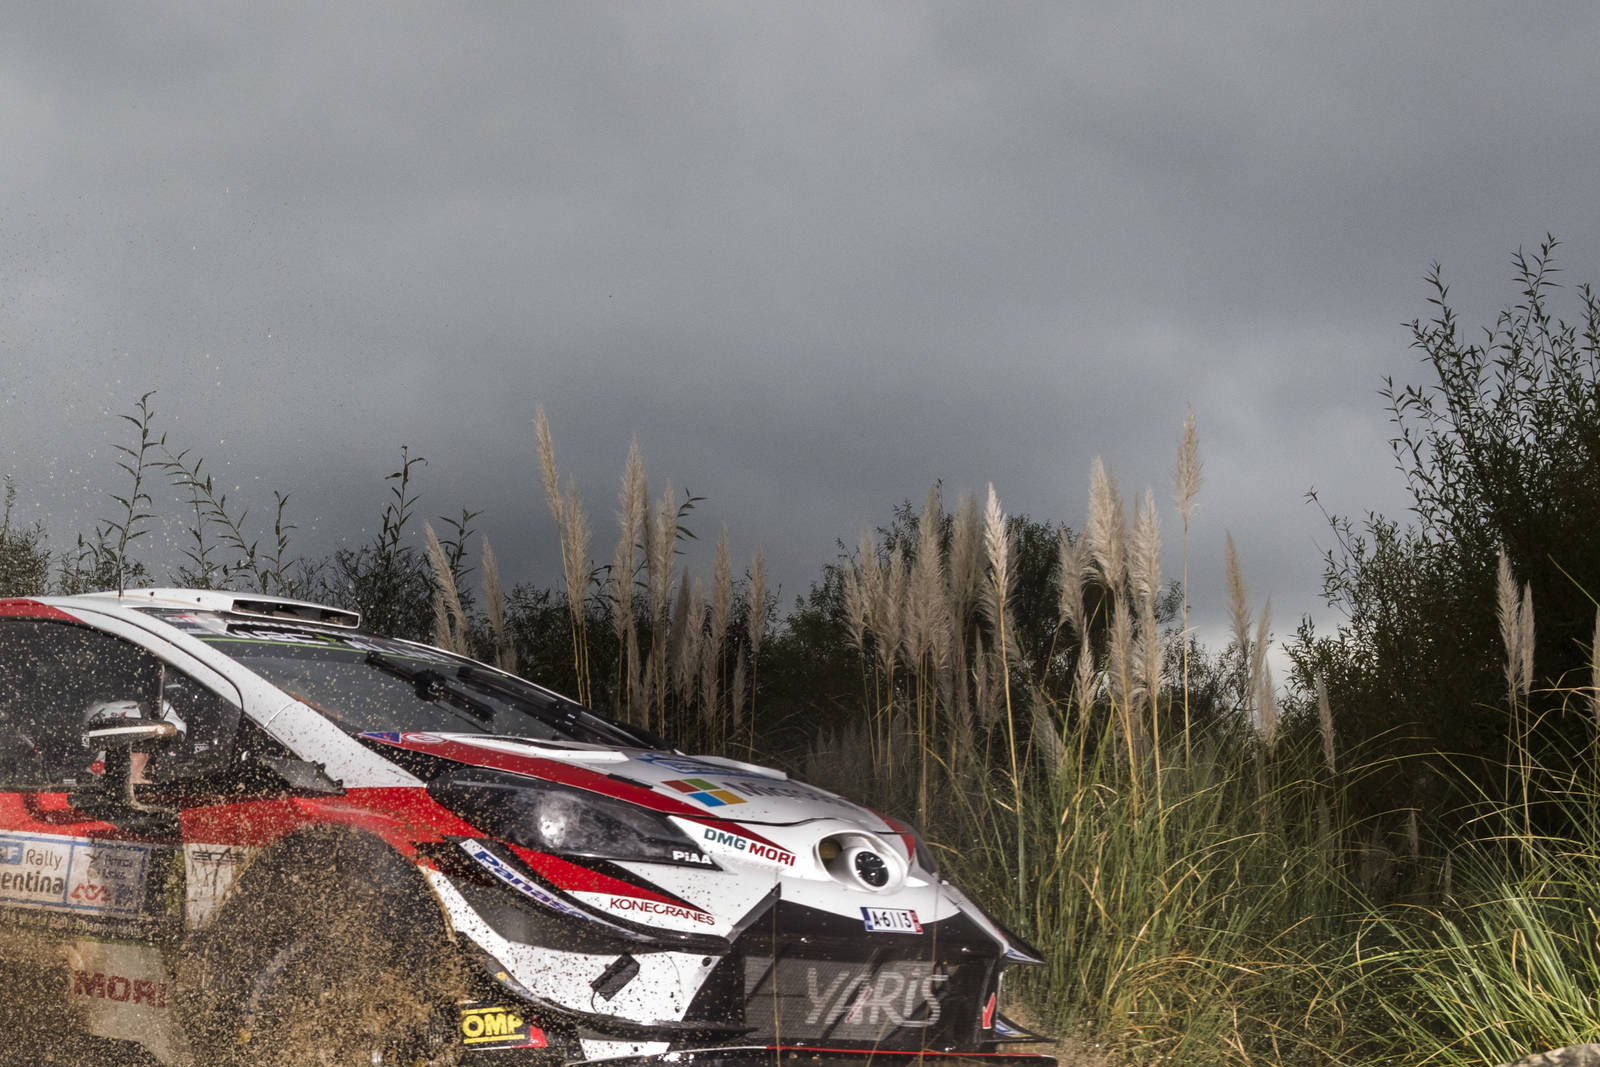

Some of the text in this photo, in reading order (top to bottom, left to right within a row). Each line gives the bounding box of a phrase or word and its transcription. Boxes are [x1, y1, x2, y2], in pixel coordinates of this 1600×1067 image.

[25, 848, 64, 871] Rally
[703, 828, 797, 867] DMG MORI
[609, 897, 716, 926] KONECRANES
[461, 1012, 524, 1038] OMP
